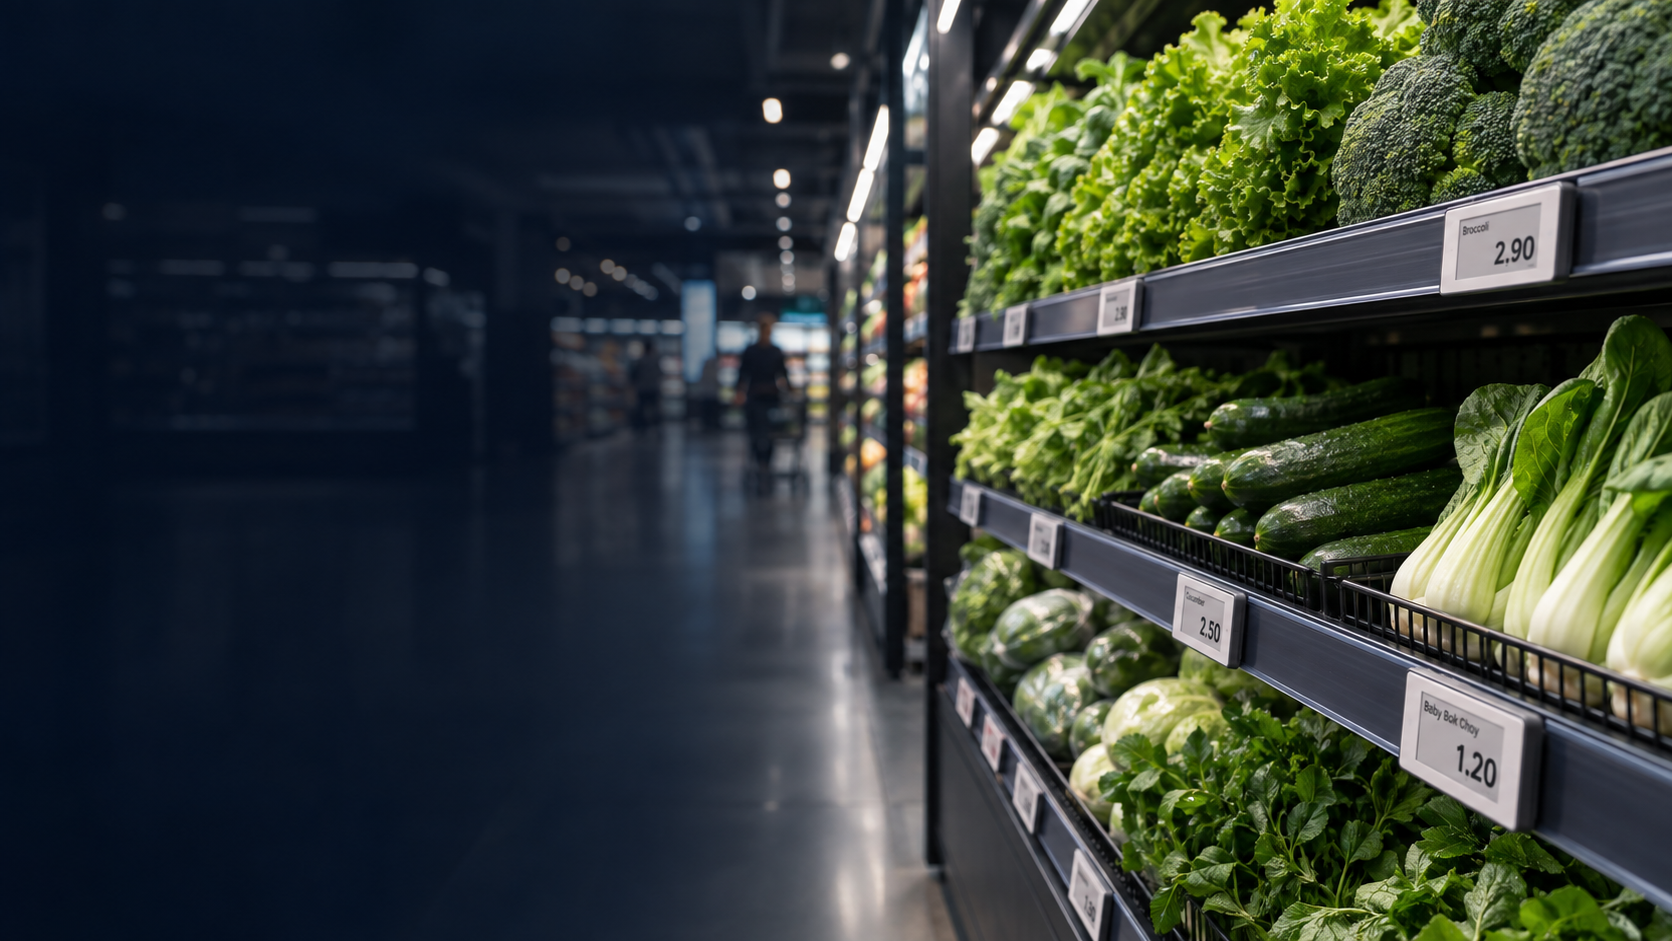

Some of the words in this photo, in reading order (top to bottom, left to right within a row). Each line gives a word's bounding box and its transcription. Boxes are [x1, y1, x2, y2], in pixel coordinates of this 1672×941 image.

[1462, 221, 1489, 236] Broccoli
[1494, 235, 1535, 265] 2.90
[1200, 616, 1221, 643] 2.50
[1424, 700, 1443, 721] Baby
[1443, 710, 1458, 726] Bok
[1459, 717, 1480, 739] Choy
[1457, 744, 1497, 788] 1.20
